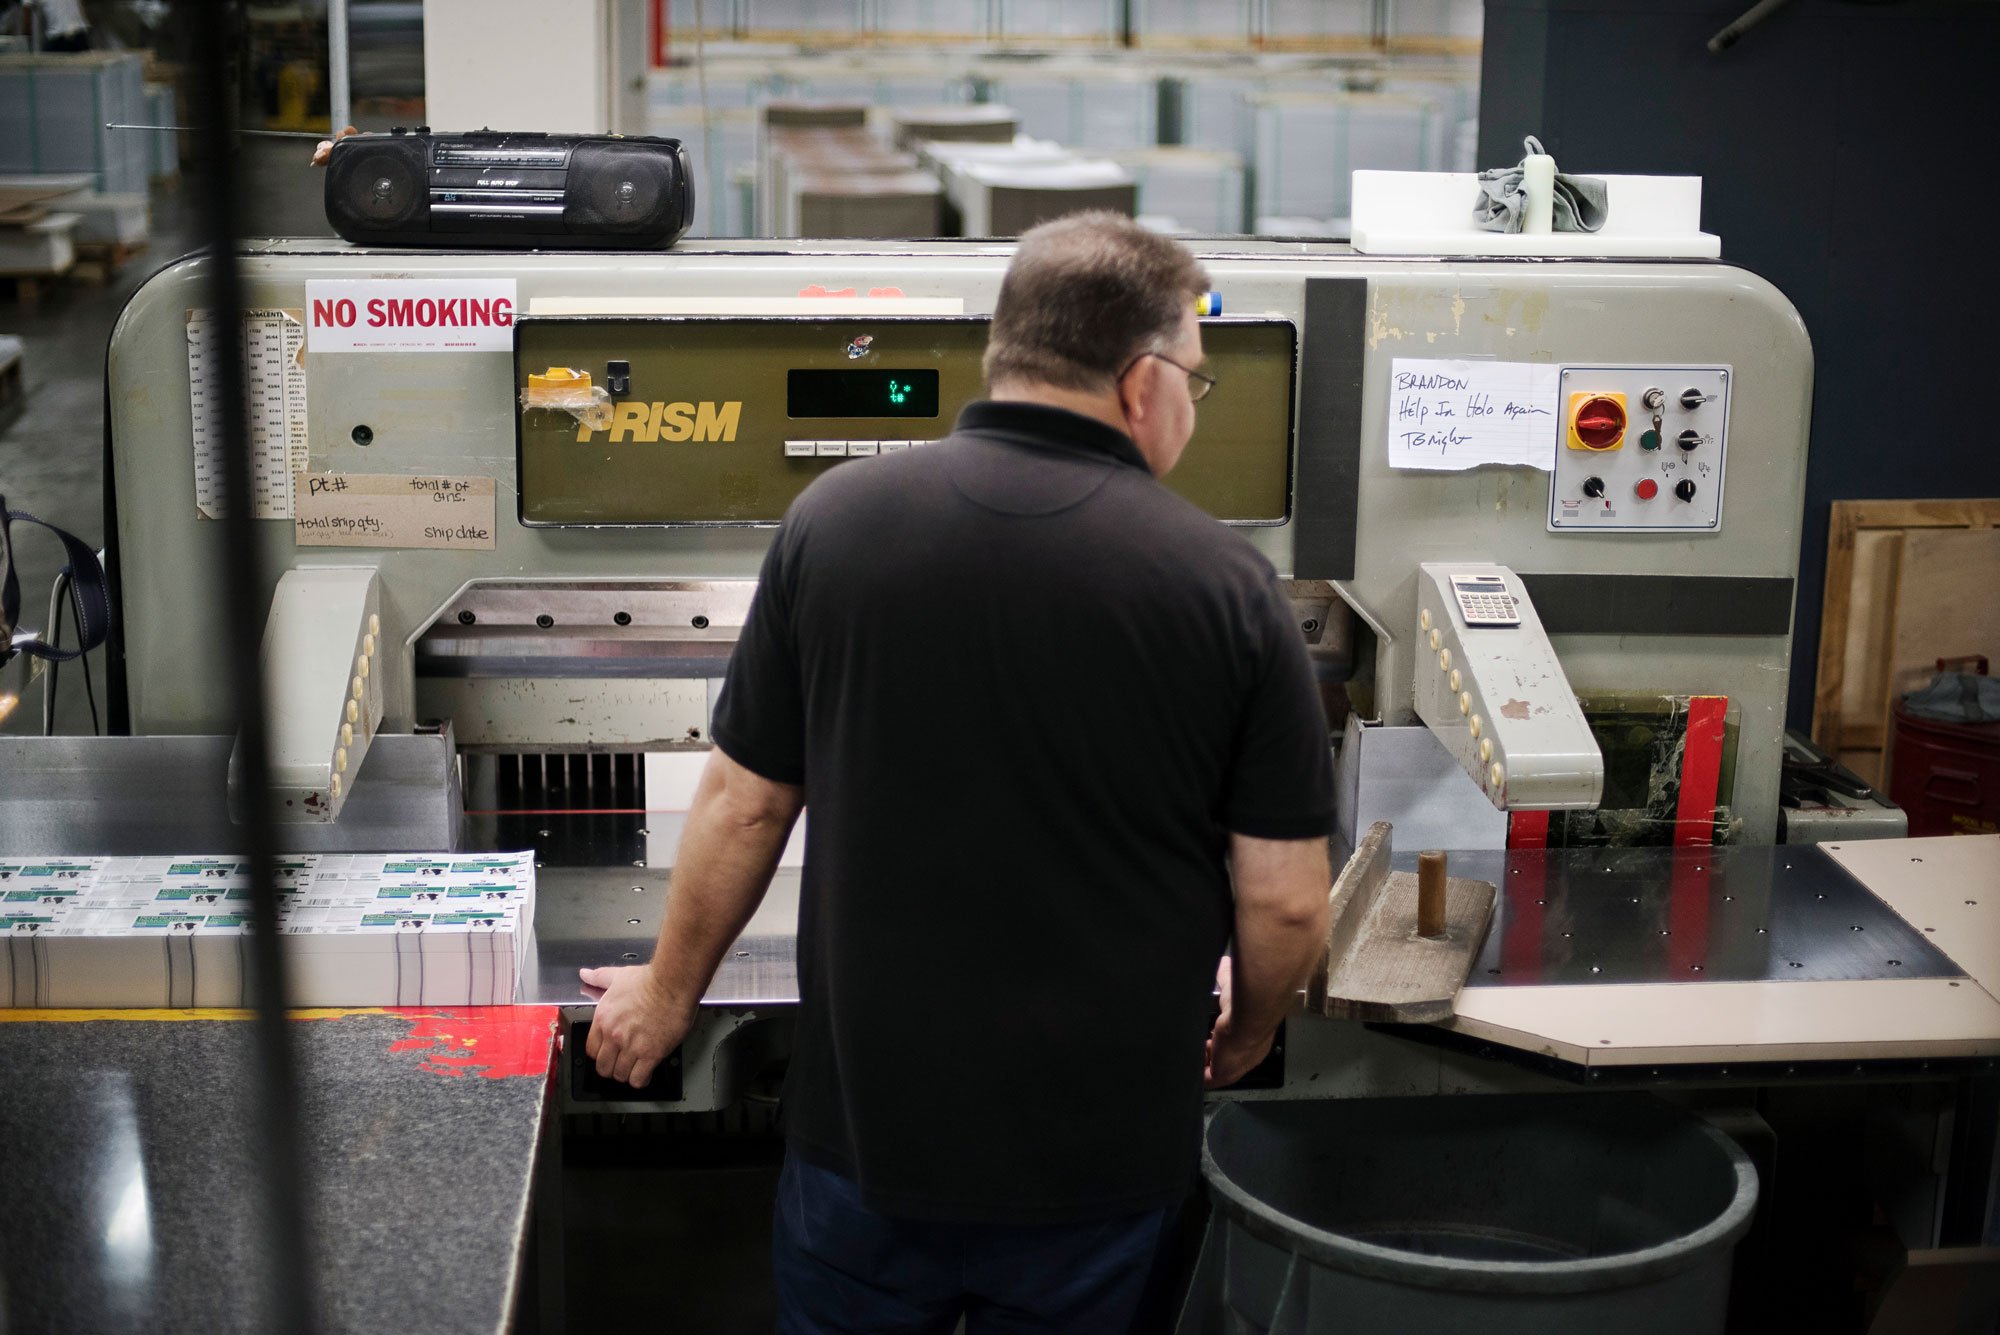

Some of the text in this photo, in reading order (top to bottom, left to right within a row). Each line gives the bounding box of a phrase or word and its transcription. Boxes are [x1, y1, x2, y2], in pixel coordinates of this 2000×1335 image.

[313, 298, 513, 328] NO SMOKING
[1394, 372, 1470, 390] BRANDON
[1399, 393, 1552, 425] Help In Holo Again
[576, 401, 742, 443] PRISM
[409, 477, 470, 492] total # of
[297, 516, 384, 532] total ship qty.
[424, 526, 489, 541] ship date
